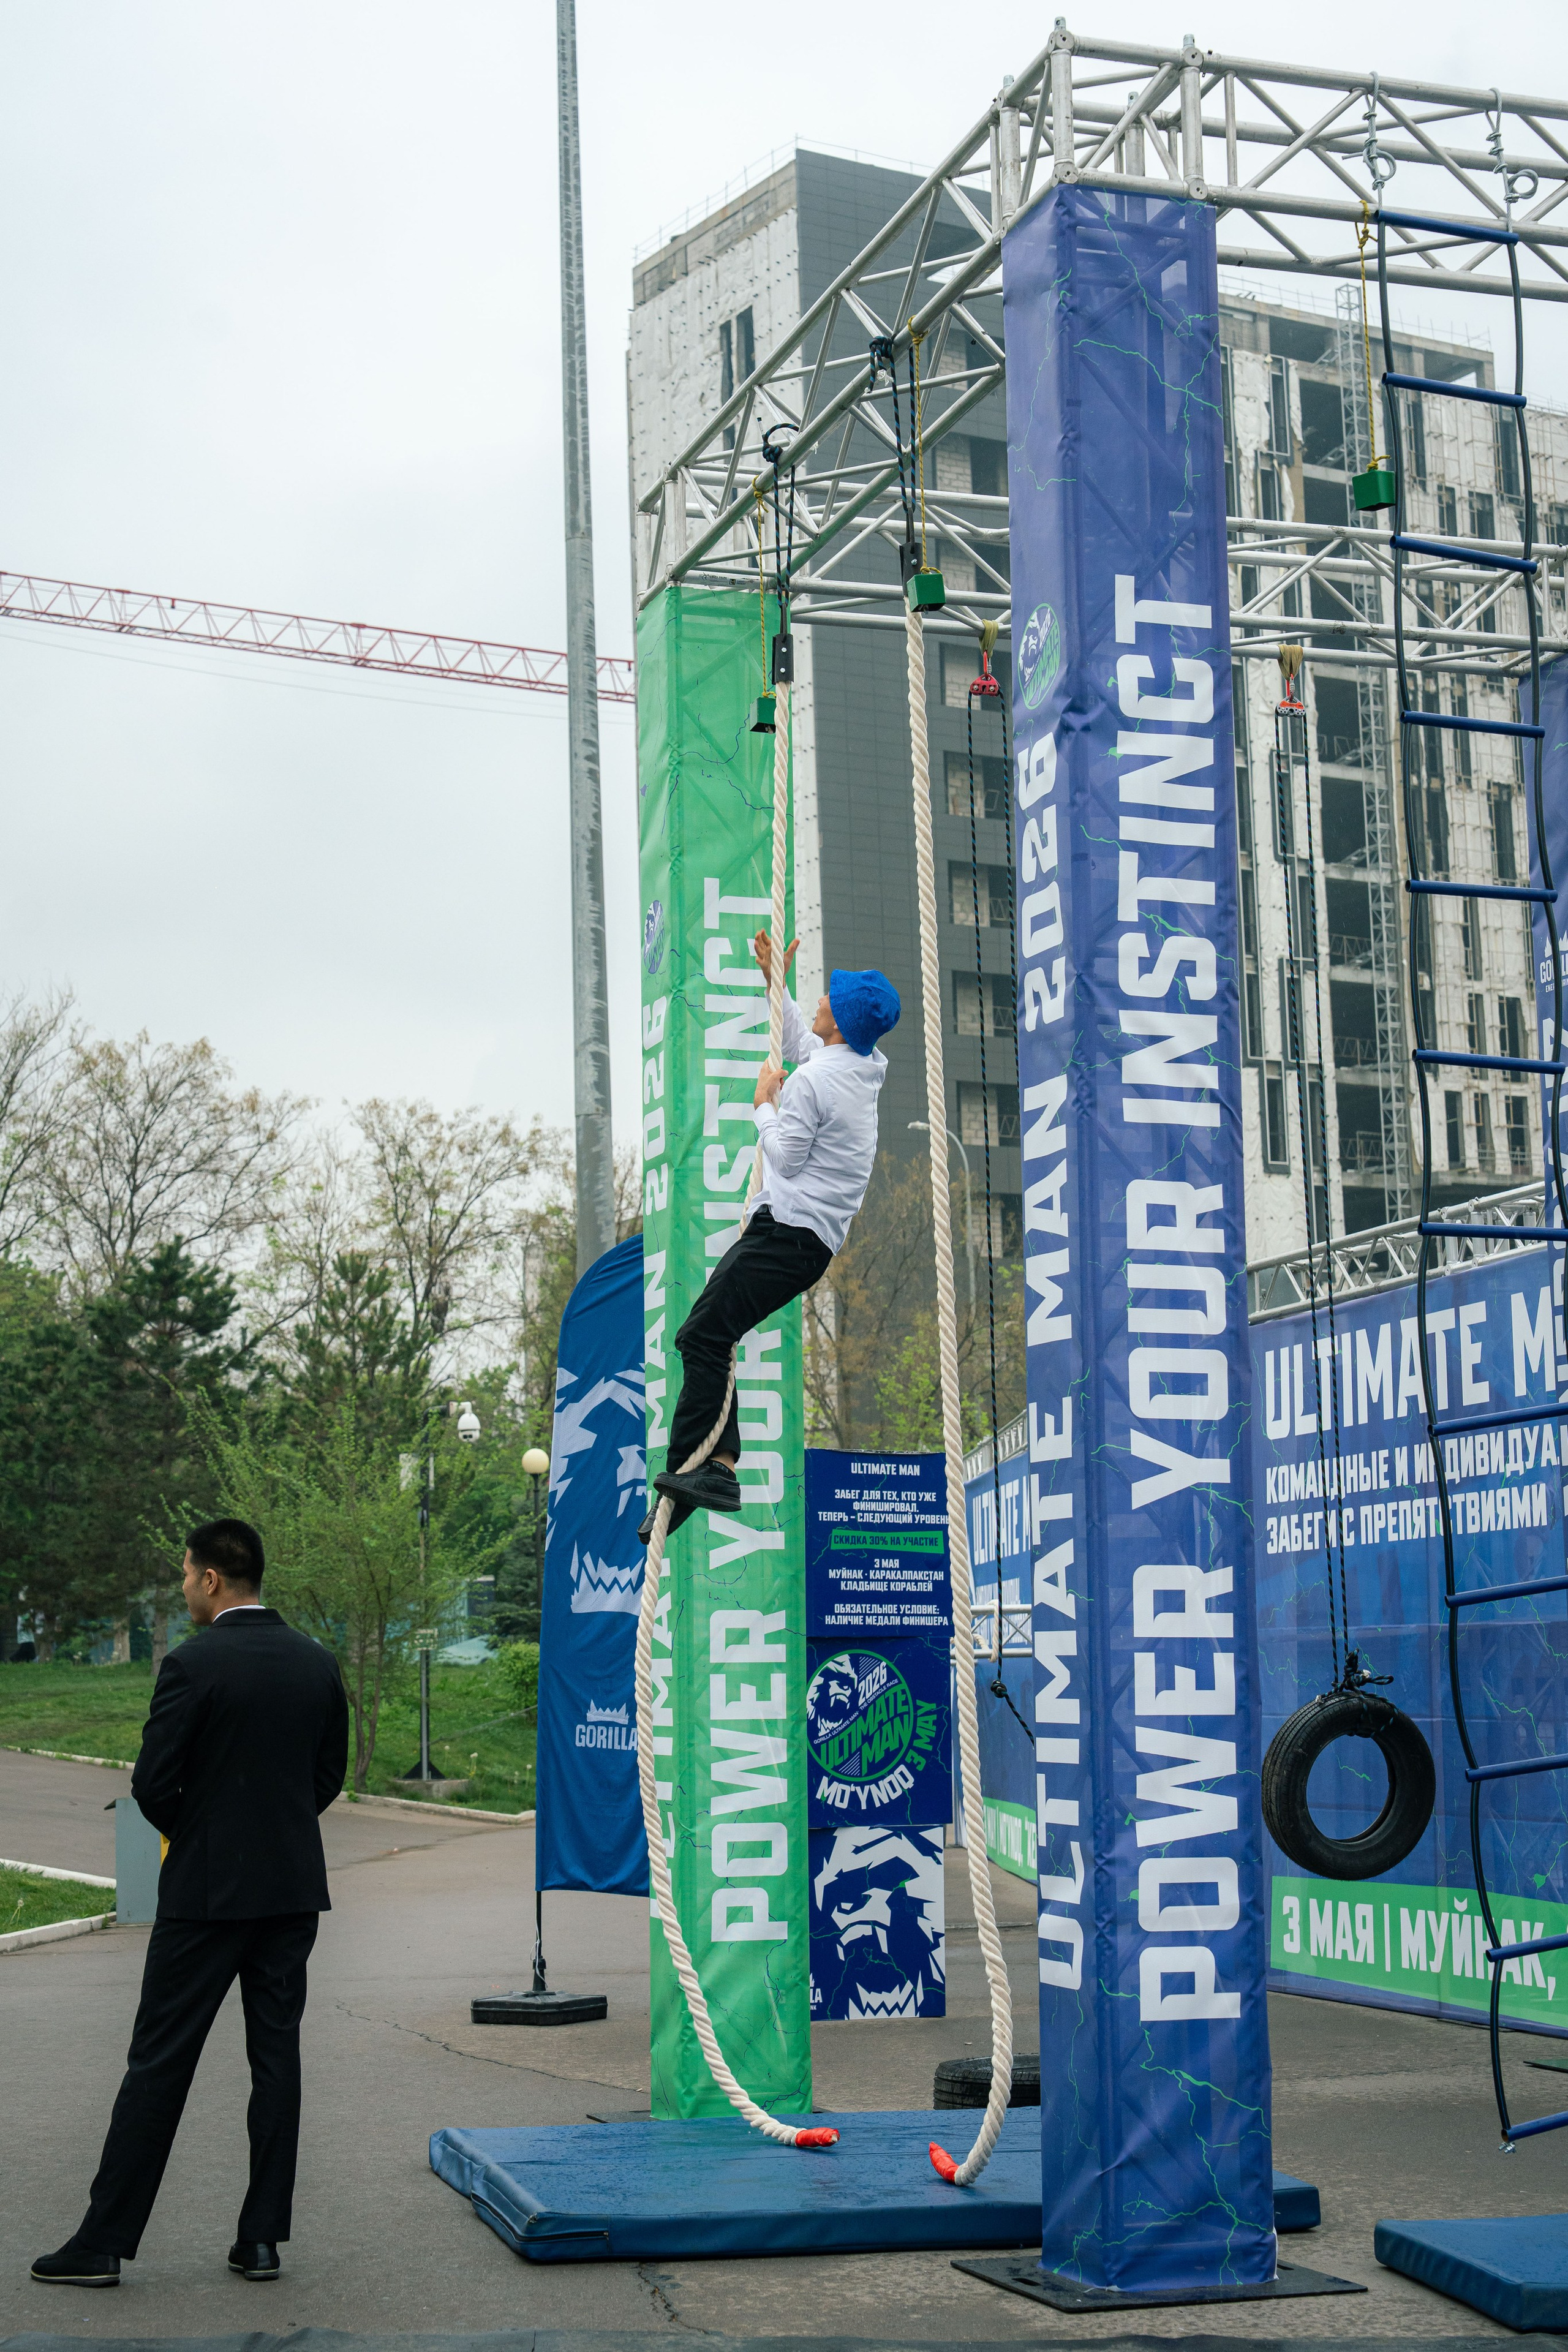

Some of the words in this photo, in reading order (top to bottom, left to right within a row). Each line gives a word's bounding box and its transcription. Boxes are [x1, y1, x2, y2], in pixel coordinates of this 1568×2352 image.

[1115, 574, 1220, 1128] INSTINCT
[1018, 731, 1066, 1033] 2026
[643, 995, 668, 1216] 2026
[1023, 1073, 1072, 1346] MAN
[644, 1249, 669, 1449] MAN
[1126, 1179, 1231, 1510] YOUR
[1265, 1301, 1490, 1440] ULTIMATE
[834, 1489, 860, 1499] ЗАБЕГ
[862, 1490, 881, 1501] ДЛЯ
[883, 1491, 899, 1502] ТЕХ,
[901, 1491, 916, 1501] КТО
[918, 1492, 937, 1501] УЖЕ
[851, 1462, 897, 1475] ULTIMATE
[899, 1464, 920, 1476] MAN
[1266, 1449, 1390, 1505] КОМАНДНЫЕ
[1395, 1446, 1408, 1487] И
[818, 1512, 848, 1521] ТЕПЕРЬ
[858, 1512, 913, 1524] СЛЕДУЮЩИЙ
[853, 1501, 919, 1512] ФИНИШИРОВАЛ.
[973, 1479, 1019, 1566] ULTIMATE
[1267, 1509, 1337, 1555] ЗАБЕГИ
[834, 1535, 867, 1545] СКИДКА
[869, 1536, 888, 1545] 30%
[891, 1536, 901, 1545] НА
[903, 1536, 938, 1547] УЧАСТИЕ
[874, 1558, 880, 1568] 3
[881, 1559, 899, 1568] МАЯ
[829, 1567, 863, 1579] МУЙНАК
[869, 1570, 944, 1580] КАРАКАЛПАКСТАН
[840, 1581, 888, 1592] КЛАДБИЩЕ
[890, 1580, 933, 1591] КОРАБЛЕЙ
[825, 1615, 864, 1625] НАЛИЧИЕ
[865, 1616, 901, 1626] МЕДАЛИ
[902, 1616, 949, 1626] ФИНИШЕРА
[834, 1604, 897, 1614] ОБЯЗАТЕЛЬНОЕ
[900, 1605, 940, 1615] УСЛОВИЕ:
[813, 1733, 832, 1744] GORILLA
[831, 1721, 850, 1735] ULTIMATE
[859, 1702, 868, 1711] THE
[867, 1686, 887, 1703] OBSTACLE
[886, 1678, 899, 1689] RACE
[858, 1660, 888, 1706] 2026
[1029, 1395, 1084, 1990] ULTIMATE
[575, 1724, 638, 1751] GORILLA
[821, 1687, 910, 1770] ULTIMATE
[861, 1714, 910, 1776] MAN
[913, 1699, 937, 1751] MAY
[710, 1609, 788, 1942] POWER
[1133, 1564, 1241, 2021] POWER
[1309, 1898, 1375, 1964] МАЯ
[1400, 1896, 1556, 2001] МУЙНАК,
